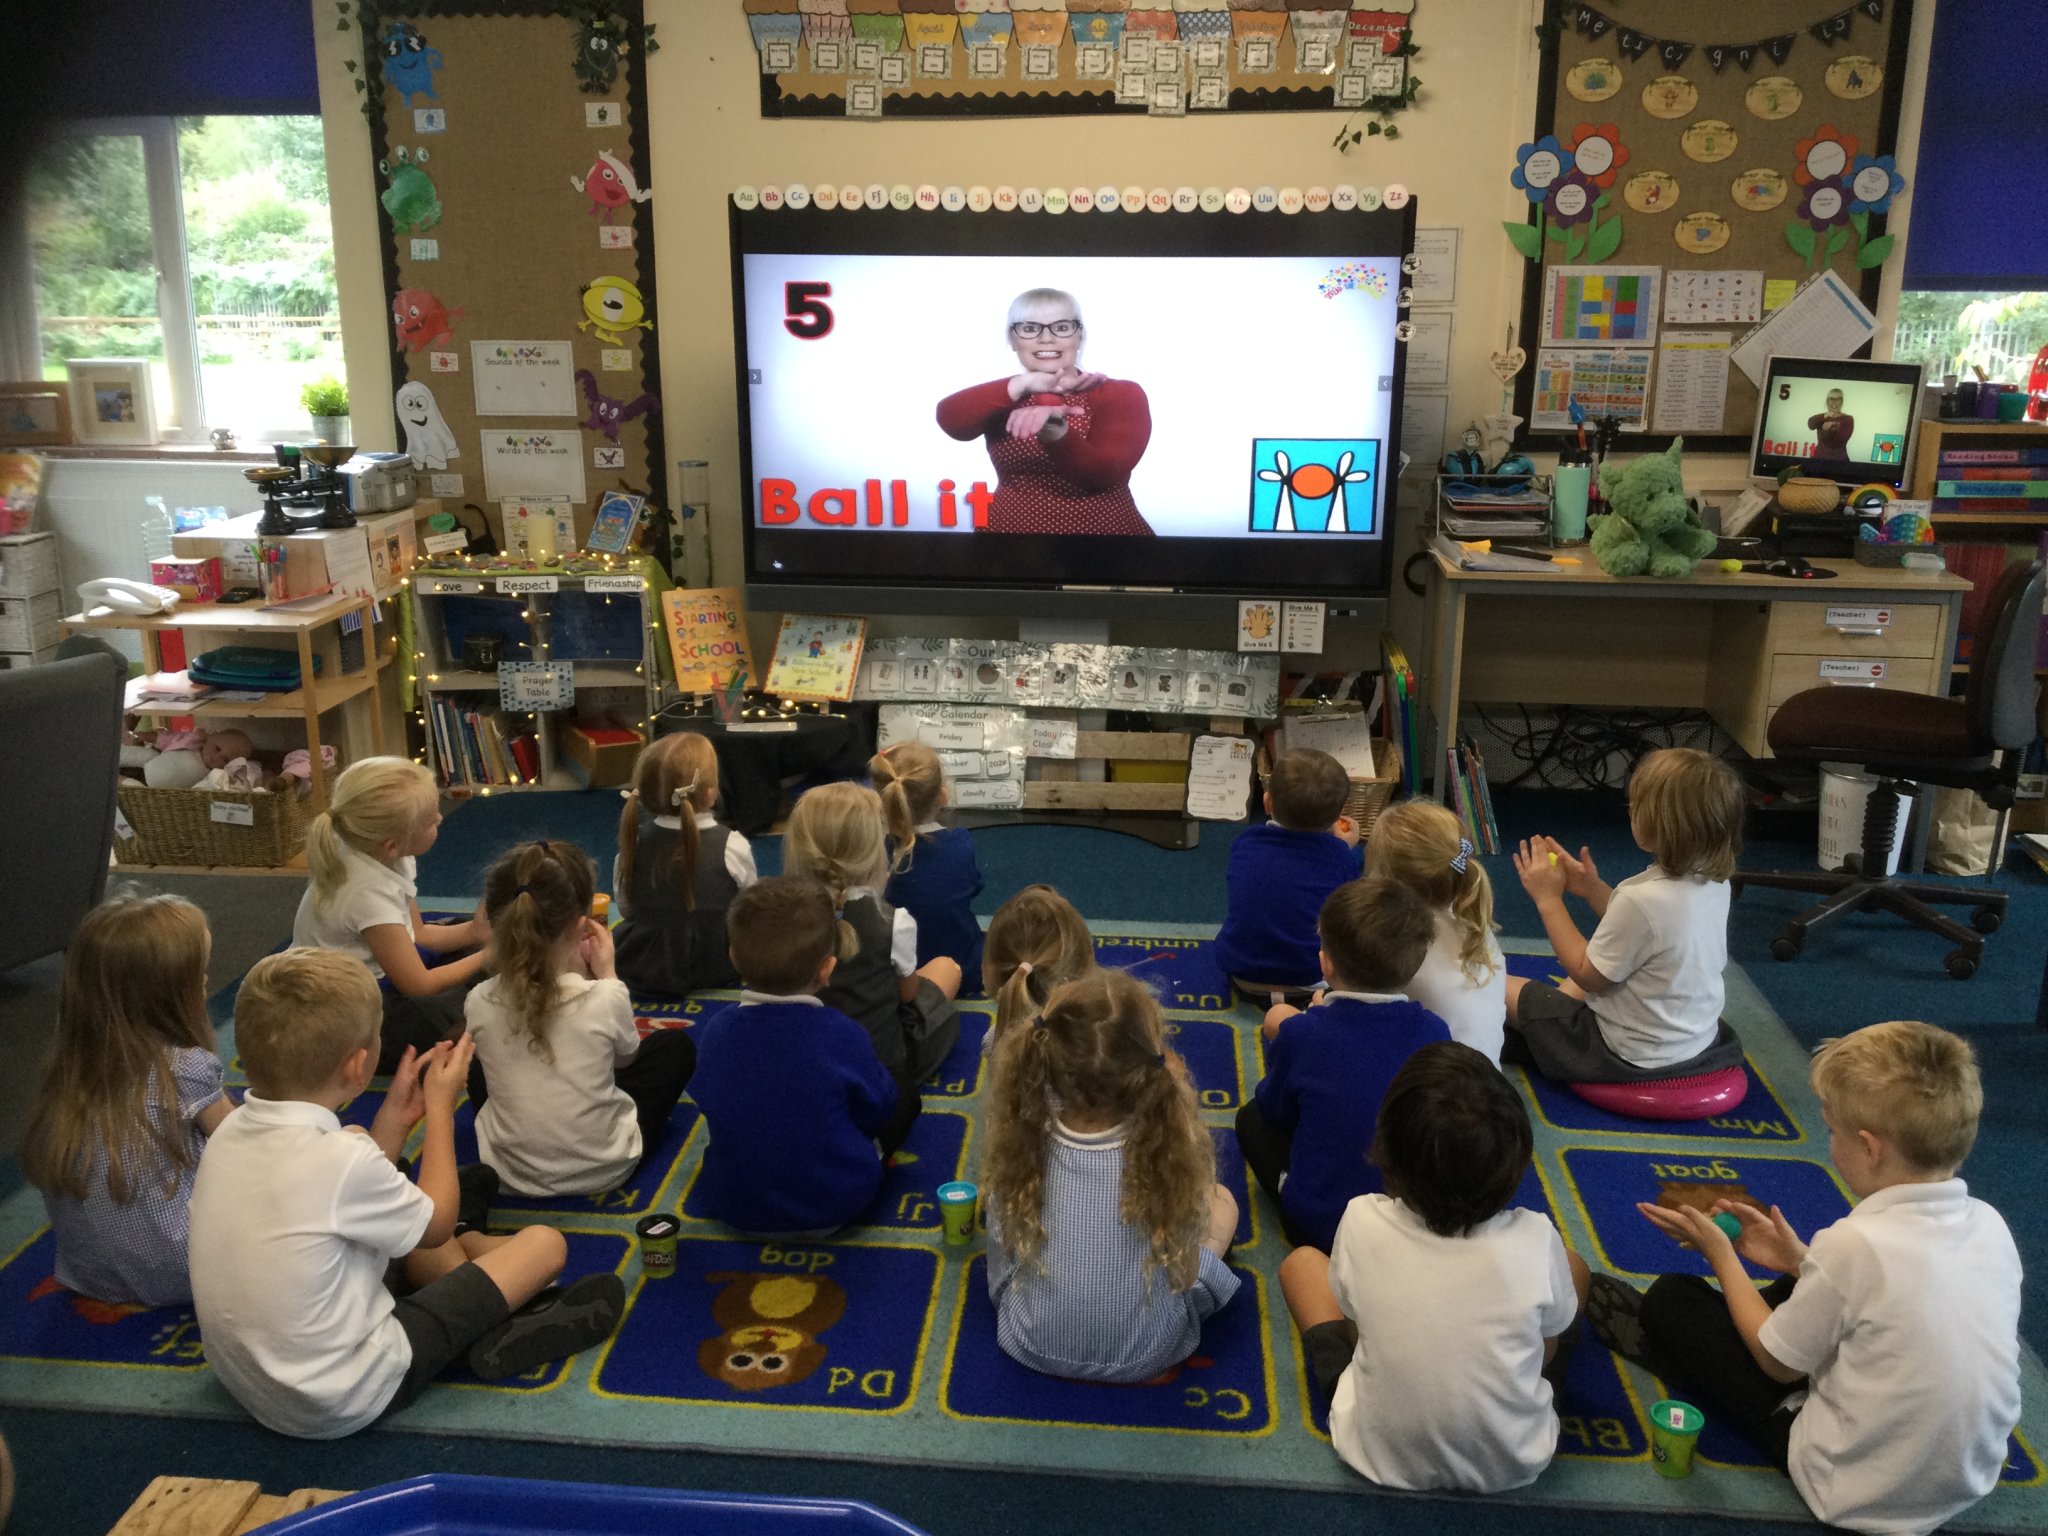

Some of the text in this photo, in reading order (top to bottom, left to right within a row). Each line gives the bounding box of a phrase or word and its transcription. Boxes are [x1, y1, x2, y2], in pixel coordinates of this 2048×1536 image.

[740, 193, 752, 201] Aa
[766, 193, 778, 201] Bb
[791, 191, 803, 200] Cc
[819, 193, 833, 201] Dd
[847, 193, 858, 201] Ee
[872, 191, 881, 203] Ff
[895, 193, 909, 203] Gg
[920, 191, 934, 201] Hh
[975, 193, 984, 205] Jj
[999, 193, 1012, 203] Kk
[1047, 196, 1065, 205] Mm
[1074, 195, 1089, 204] Nn
[1127, 195, 1140, 206] Pp
[1152, 195, 1167, 206] Qq
[1180, 195, 1191, 203] Rr
[1206, 195, 1219, 203] Ss
[1258, 194, 1272, 203] Uu
[1307, 194, 1328, 204] Ww
[1338, 193, 1352, 202] Xx
[1363, 194, 1376, 204] Yy
[1390, 191, 1402, 201] Zz
[783, 281, 834, 340] 5
[484, 358, 512, 366] Sounds
[541, 358, 561, 366] week
[1779, 384, 1791, 400] 5
[1763, 439, 1817, 456] Ball it
[760, 478, 994, 529] Ball it
[434, 580, 462, 592] Love
[503, 580, 551, 593] Respect
[673, 611, 738, 626] STARTING
[678, 640, 745, 659] SCHOOL
[967, 645, 995, 658] Our
[522, 675, 553, 687] Prayer
[525, 687, 550, 696] Table
[915, 709, 989, 719] Our Calendar
[938, 732, 963, 743] Friday
[1032, 729, 1057, 740] Today
[962, 789, 986, 799] cloudy
[1708, 1116, 1788, 1136] Mm
[1650, 1160, 1739, 1180] goat
[759, 1245, 835, 1273] dog
[827, 1366, 896, 1398] Dd
[1184, 1386, 1252, 1420] Cc
